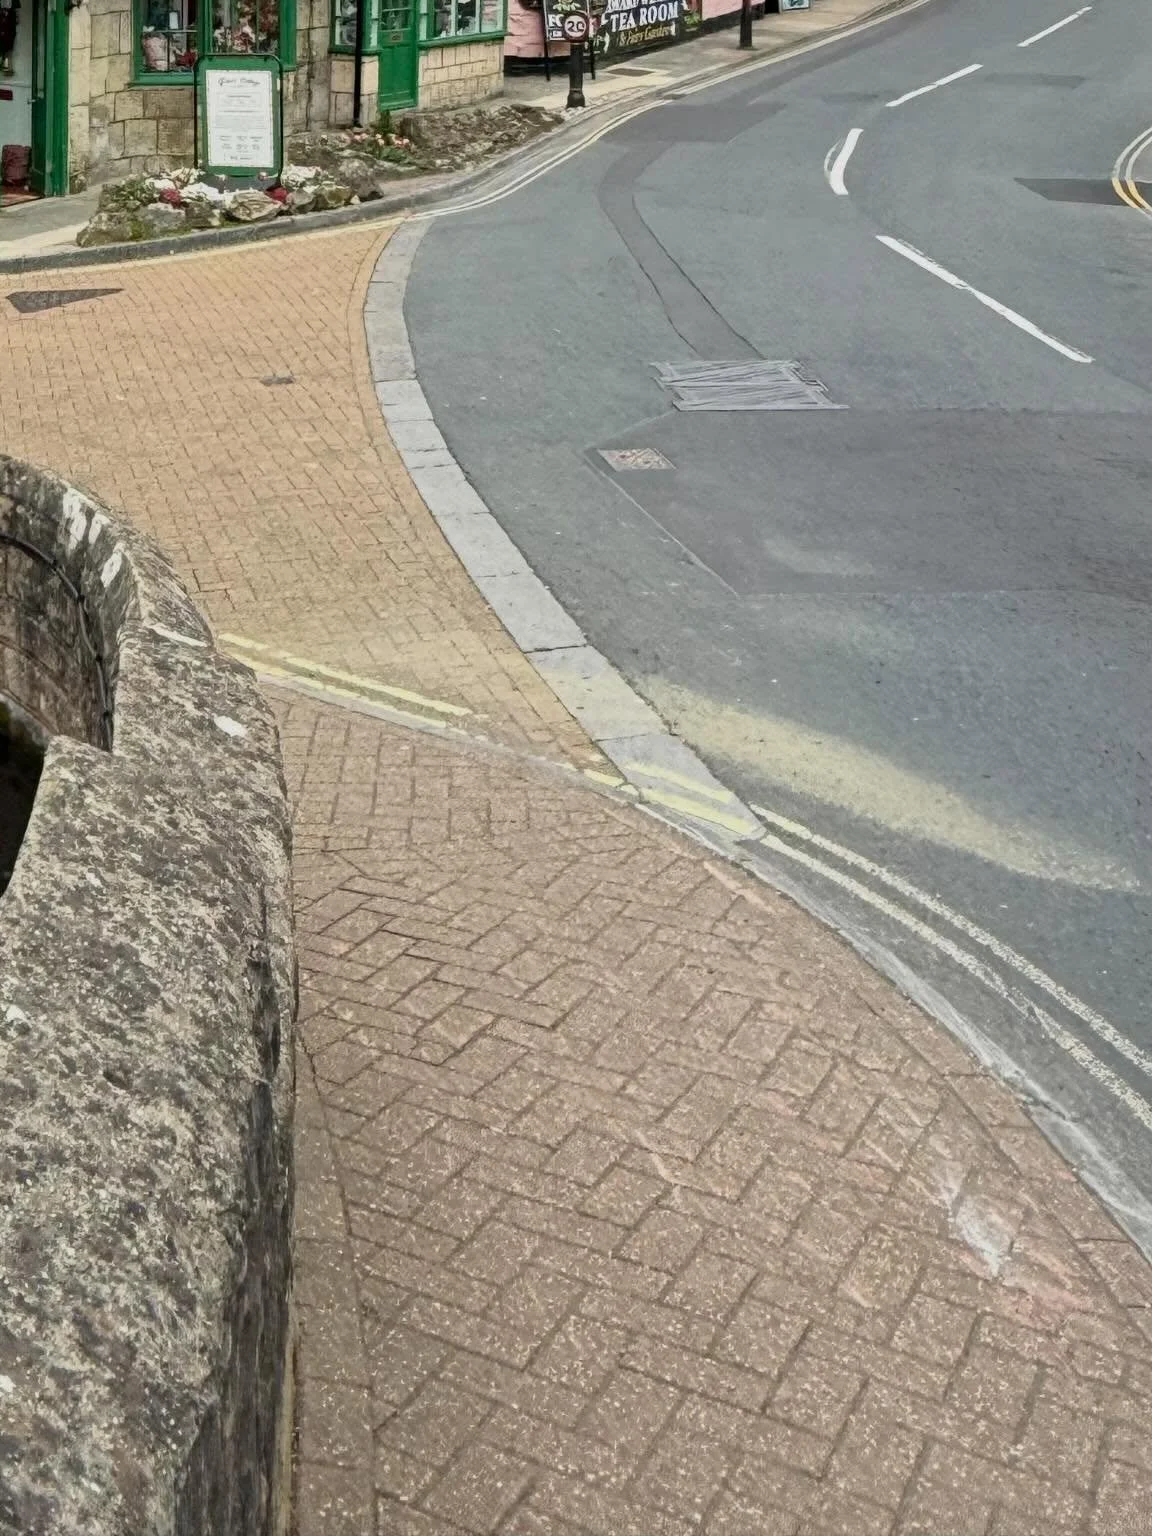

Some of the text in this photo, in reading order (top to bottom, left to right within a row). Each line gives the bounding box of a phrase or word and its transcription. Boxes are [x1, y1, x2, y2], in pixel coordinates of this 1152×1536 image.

[567, 20, 586, 33] 20
[610, 1, 679, 33] TEA ROOM
